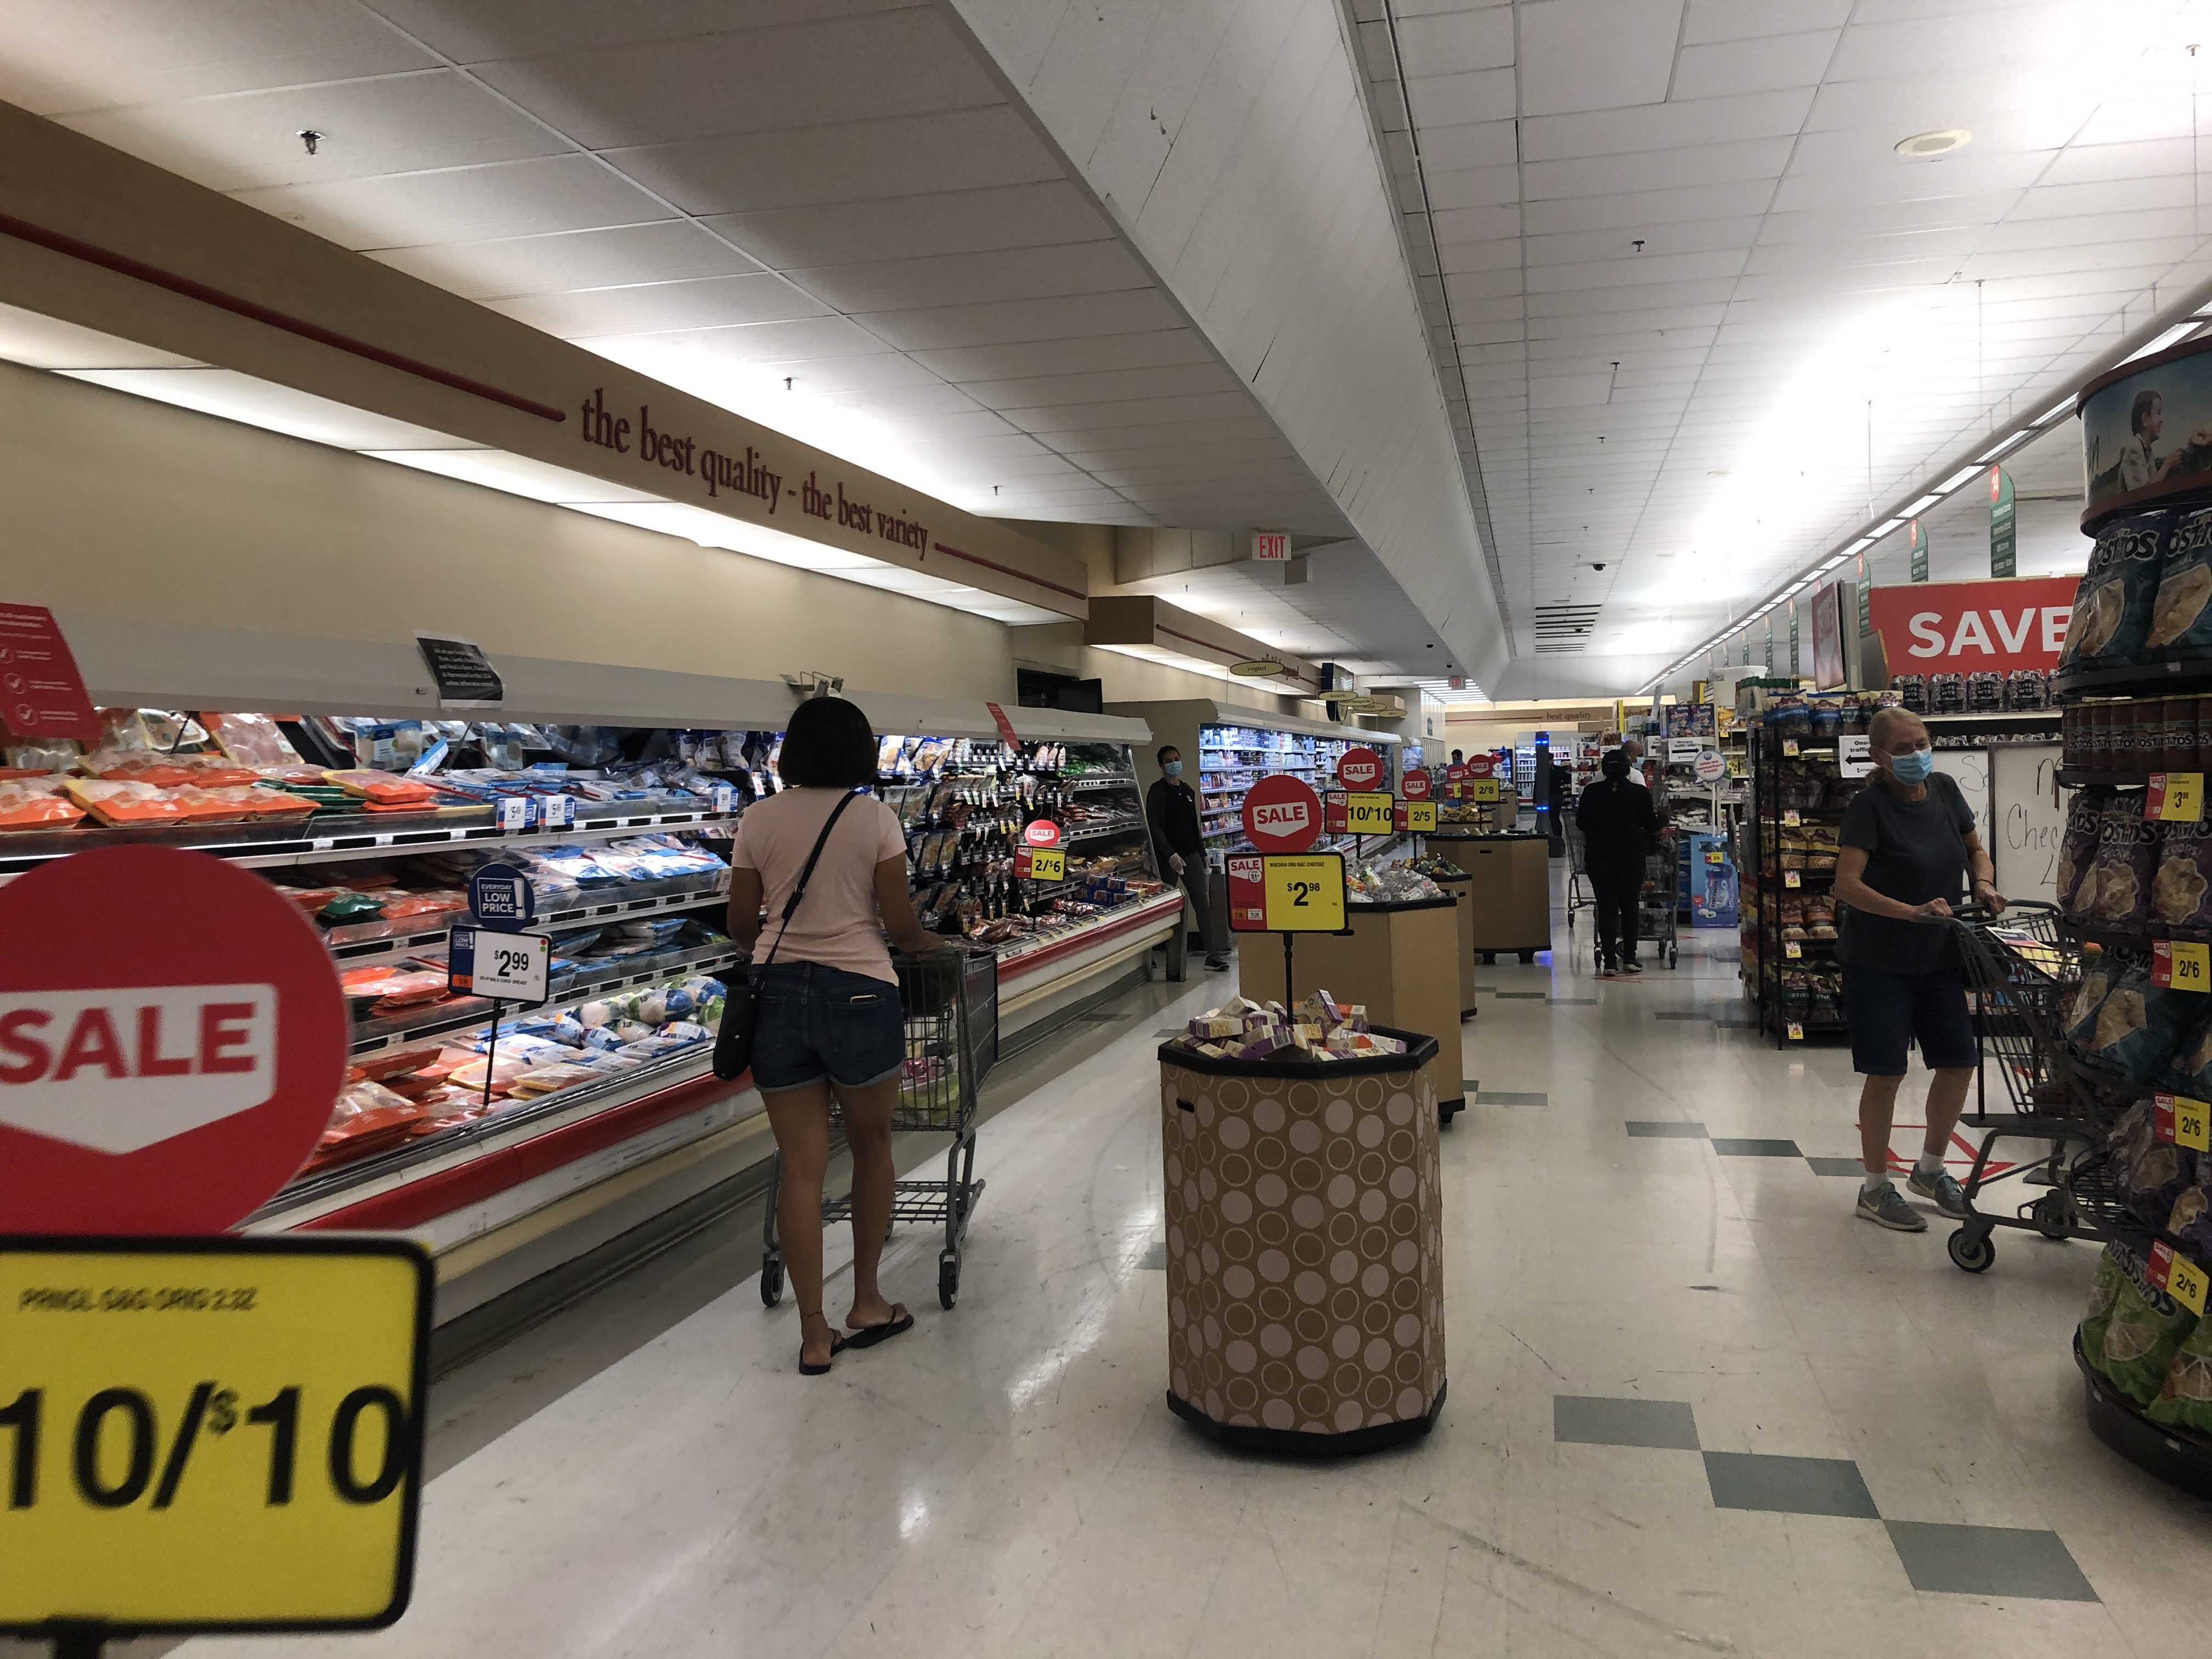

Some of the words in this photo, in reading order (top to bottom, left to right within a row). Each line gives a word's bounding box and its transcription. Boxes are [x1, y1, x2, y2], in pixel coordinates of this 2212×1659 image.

[581, 387, 630, 453] the
[640, 404, 696, 476] best
[701, 446, 783, 515] quality
[803, 470, 833, 520] the
[837, 482, 873, 534] best
[877, 508, 929, 561] variety
[1260, 535, 1285, 558] EXIT
[1908, 606, 2074, 658] SAVE
[1565, 713, 1590, 721] quality
[1345, 765, 1373, 775] SALE
[1257, 805, 1305, 824] SALE
[1035, 859, 1060, 873] 2/$6
[1231, 860, 1260, 871] SALE
[484, 893, 510, 902] LOW
[482, 903, 514, 913] PRICE
[0, 1002, 258, 1085] SALE
[0, 1382, 409, 1511] 10/$10
